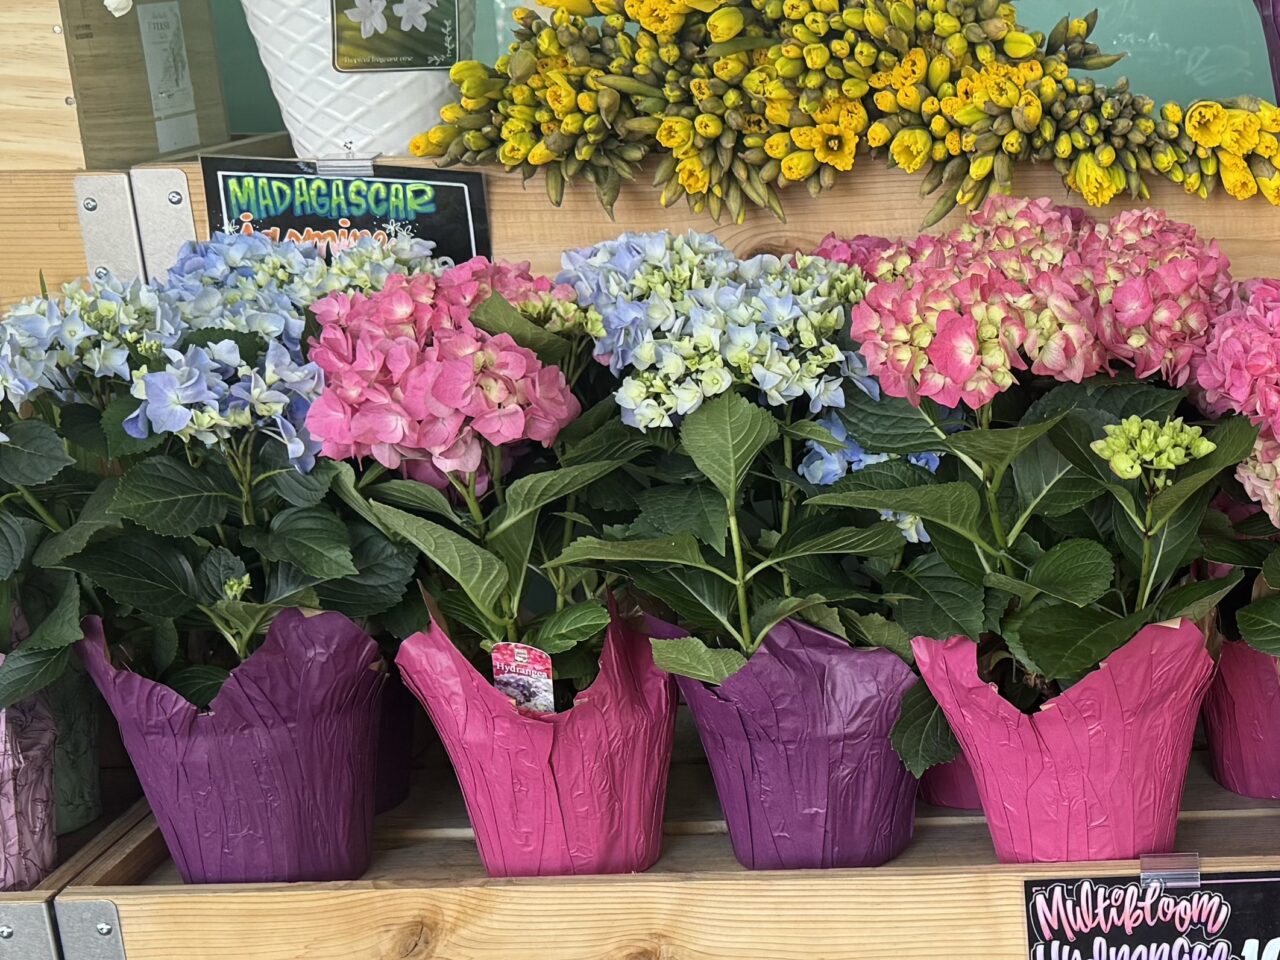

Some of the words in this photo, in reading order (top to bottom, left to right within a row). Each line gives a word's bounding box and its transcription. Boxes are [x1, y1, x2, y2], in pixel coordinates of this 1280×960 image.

[228, 175, 437, 220] MADAGASCAR
[496, 661, 548, 679] Hydrangea
[1034, 880, 1226, 942] Multibloom
